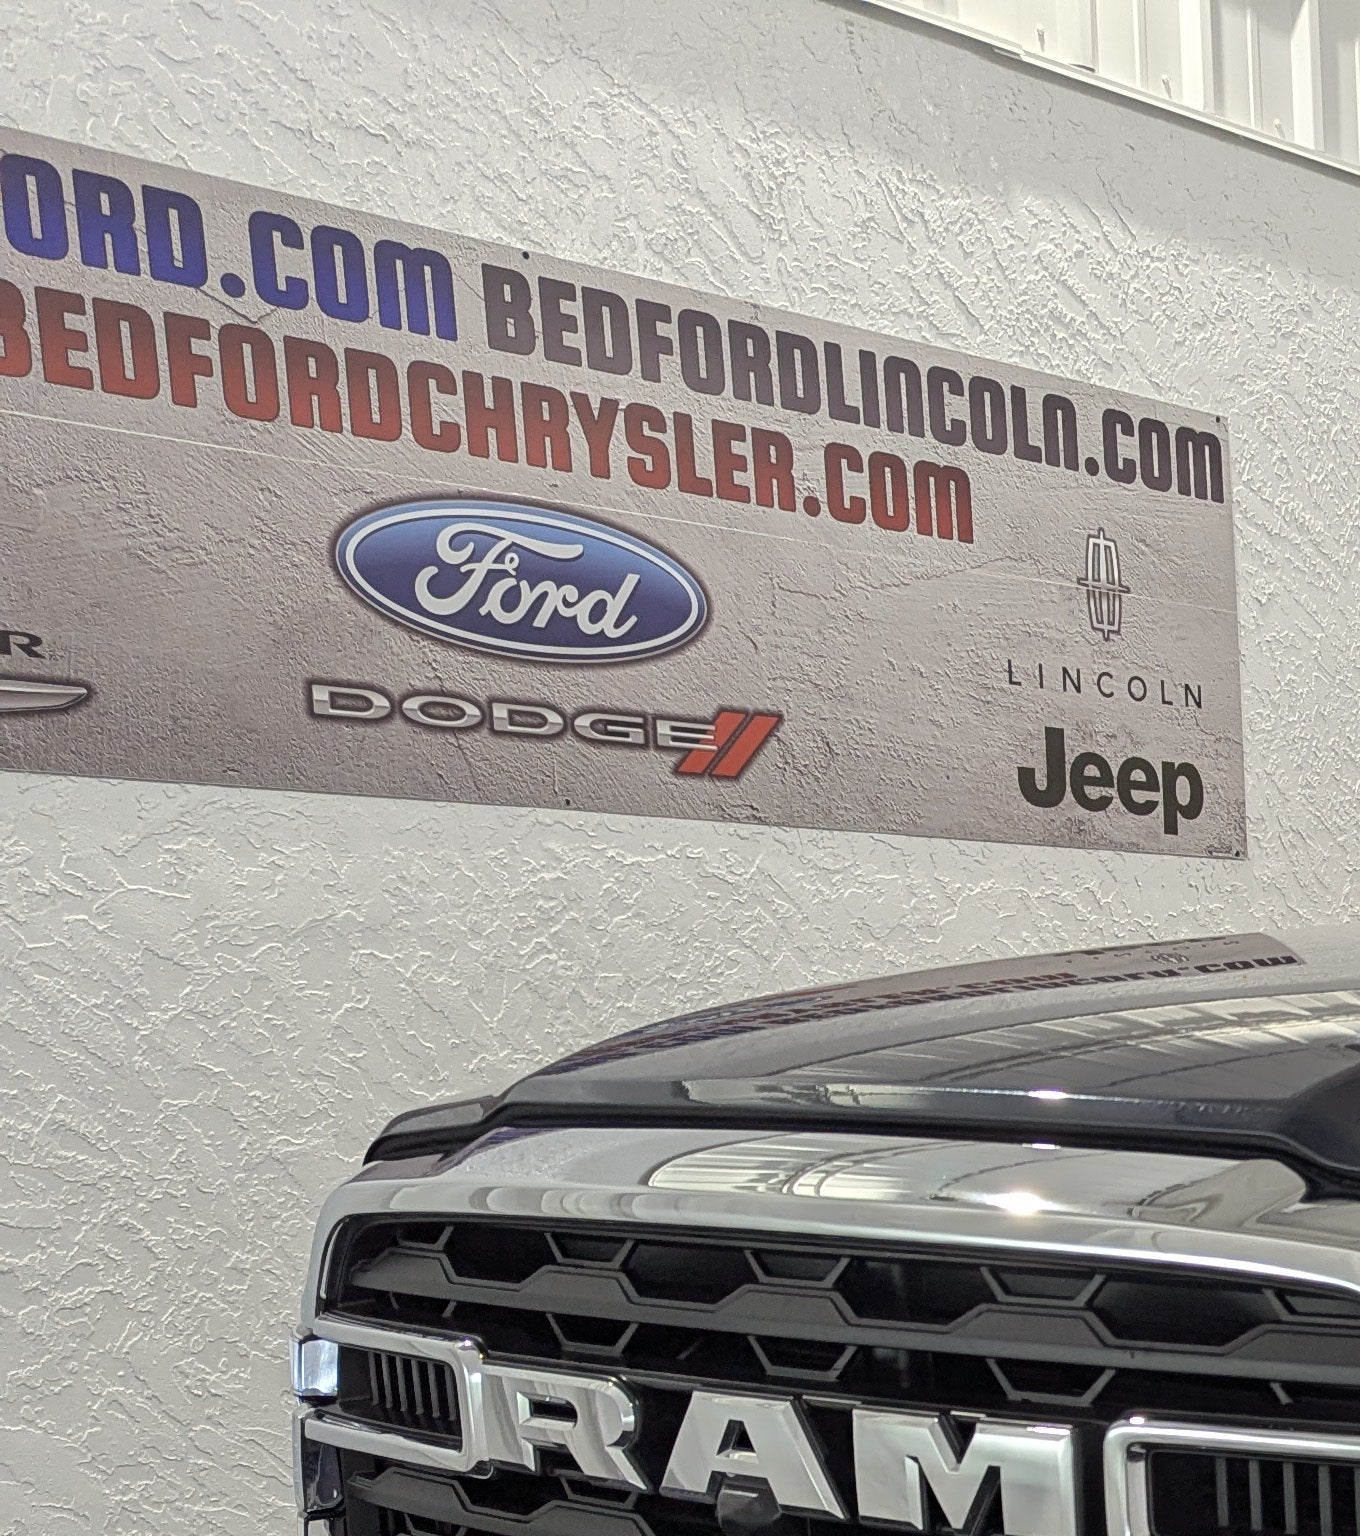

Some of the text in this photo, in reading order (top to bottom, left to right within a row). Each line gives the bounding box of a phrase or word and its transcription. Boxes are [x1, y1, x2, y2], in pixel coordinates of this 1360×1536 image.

[482, 262, 1225, 504] BEDFORDLINCOLN.COM
[415, 521, 640, 639] Ford
[310, 683, 718, 752] DODGE
[1007, 659, 1203, 709] LINCOLN
[1017, 726, 1204, 835] Jeep
